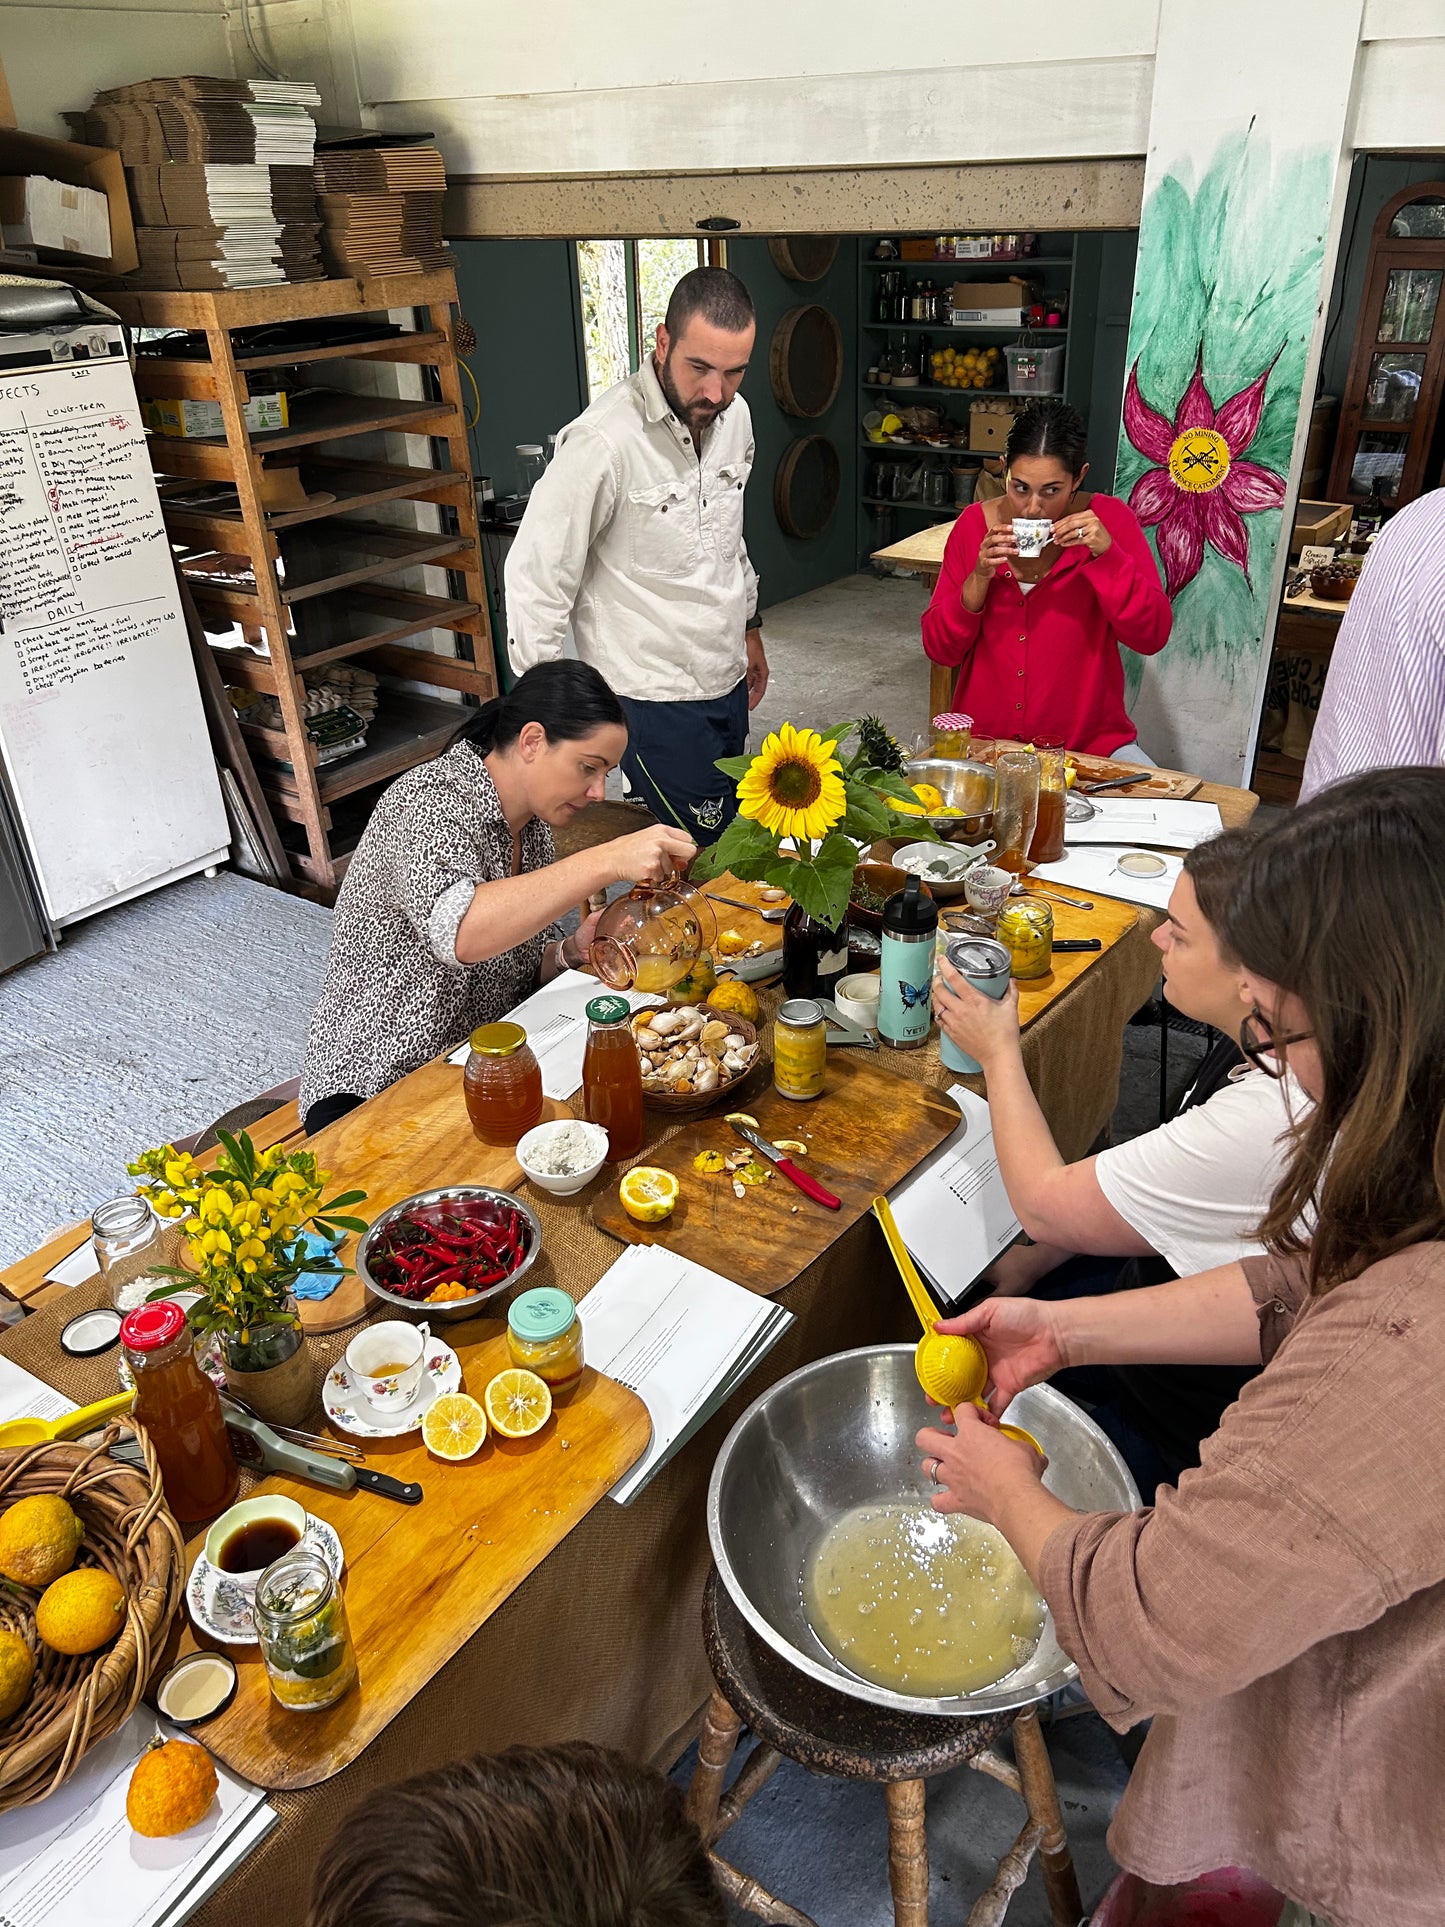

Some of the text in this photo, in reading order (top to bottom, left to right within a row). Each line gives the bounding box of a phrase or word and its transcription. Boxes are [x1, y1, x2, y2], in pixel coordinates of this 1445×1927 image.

[46, 402, 106, 417] LONG-TERM
[67, 432, 97, 441] orchard
[1183, 430, 1220, 444] NO MINING
[1171, 459, 1227, 490] CLARENCE CATCHMENT
[62, 500, 80, 510] Make
[47, 601, 85, 621] DAILY
[49, 626, 71, 637] water
[77, 618, 97, 628] tank
[64, 630, 89, 642] animal
[115, 615, 132, 627] fuel
[59, 668, 89, 684] irrigation
[94, 655, 126, 670] batteries
[906, 1025, 925, 1035] YETI
